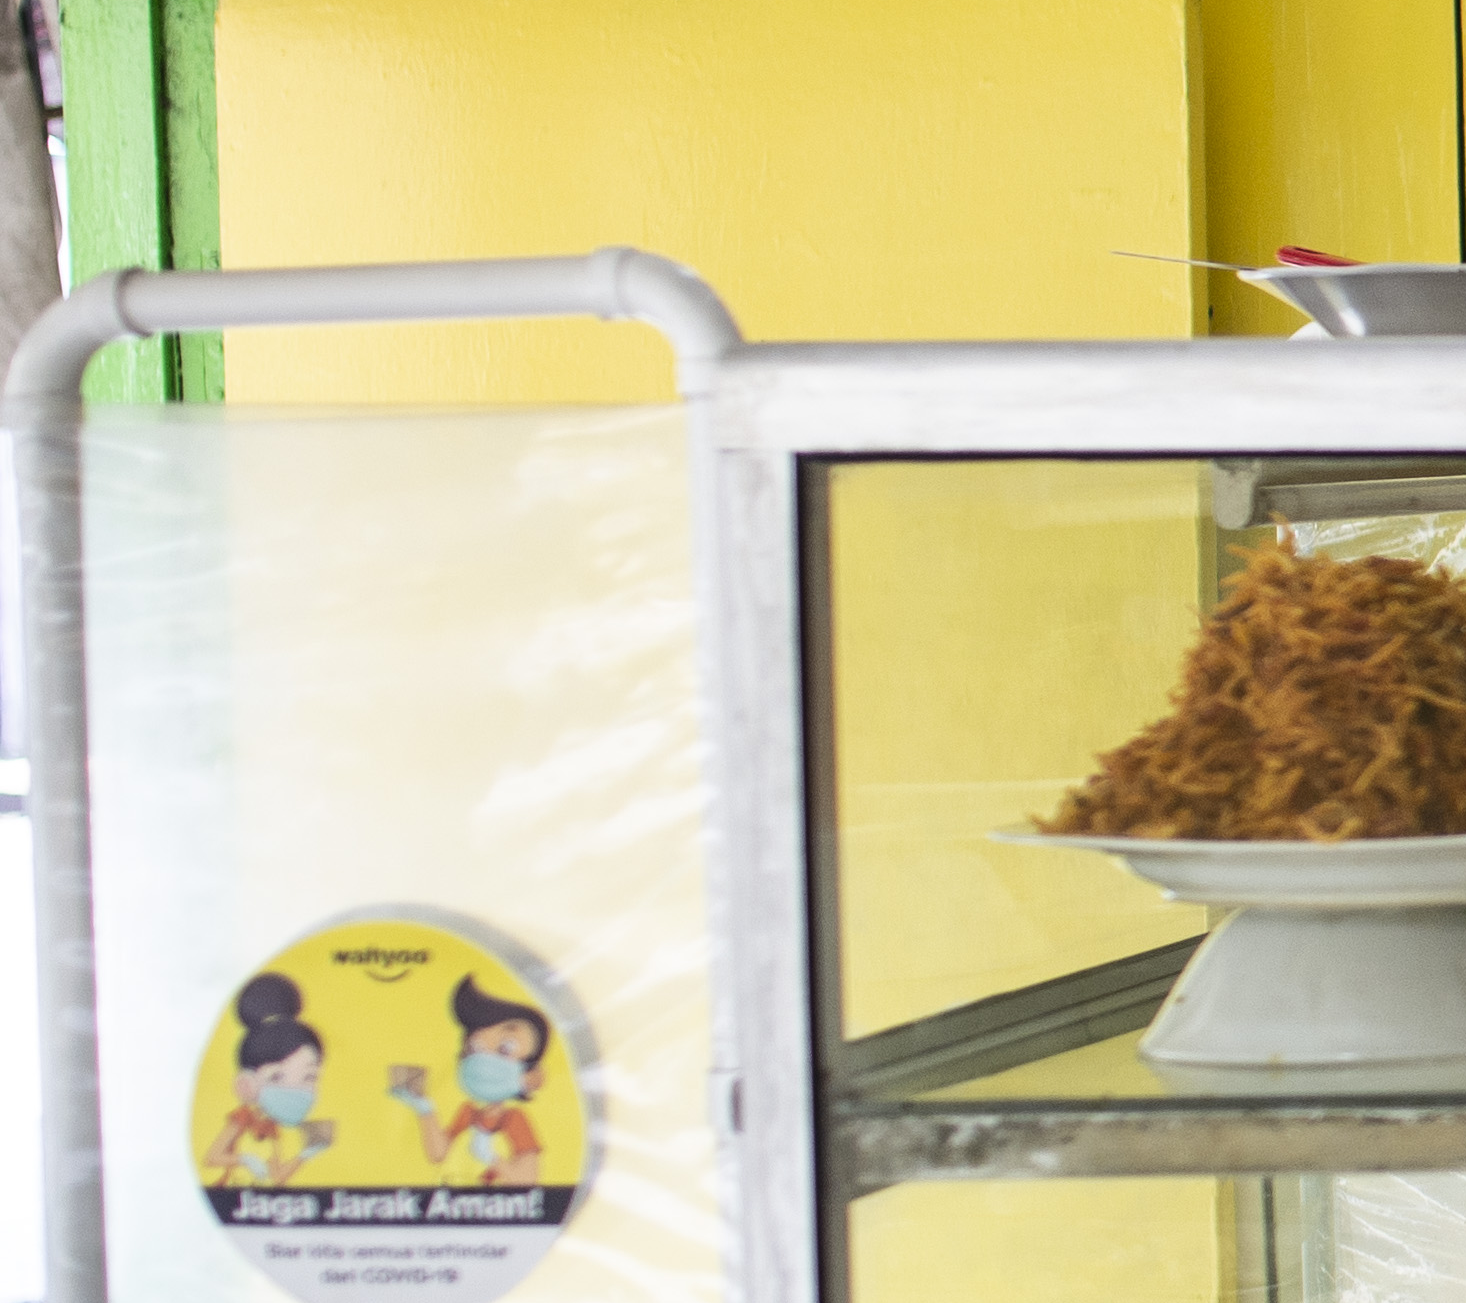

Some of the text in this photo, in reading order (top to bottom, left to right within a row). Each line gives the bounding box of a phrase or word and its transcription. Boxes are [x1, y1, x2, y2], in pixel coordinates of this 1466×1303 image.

[232, 1188, 545, 1224] Jaga Jarak Aman!
